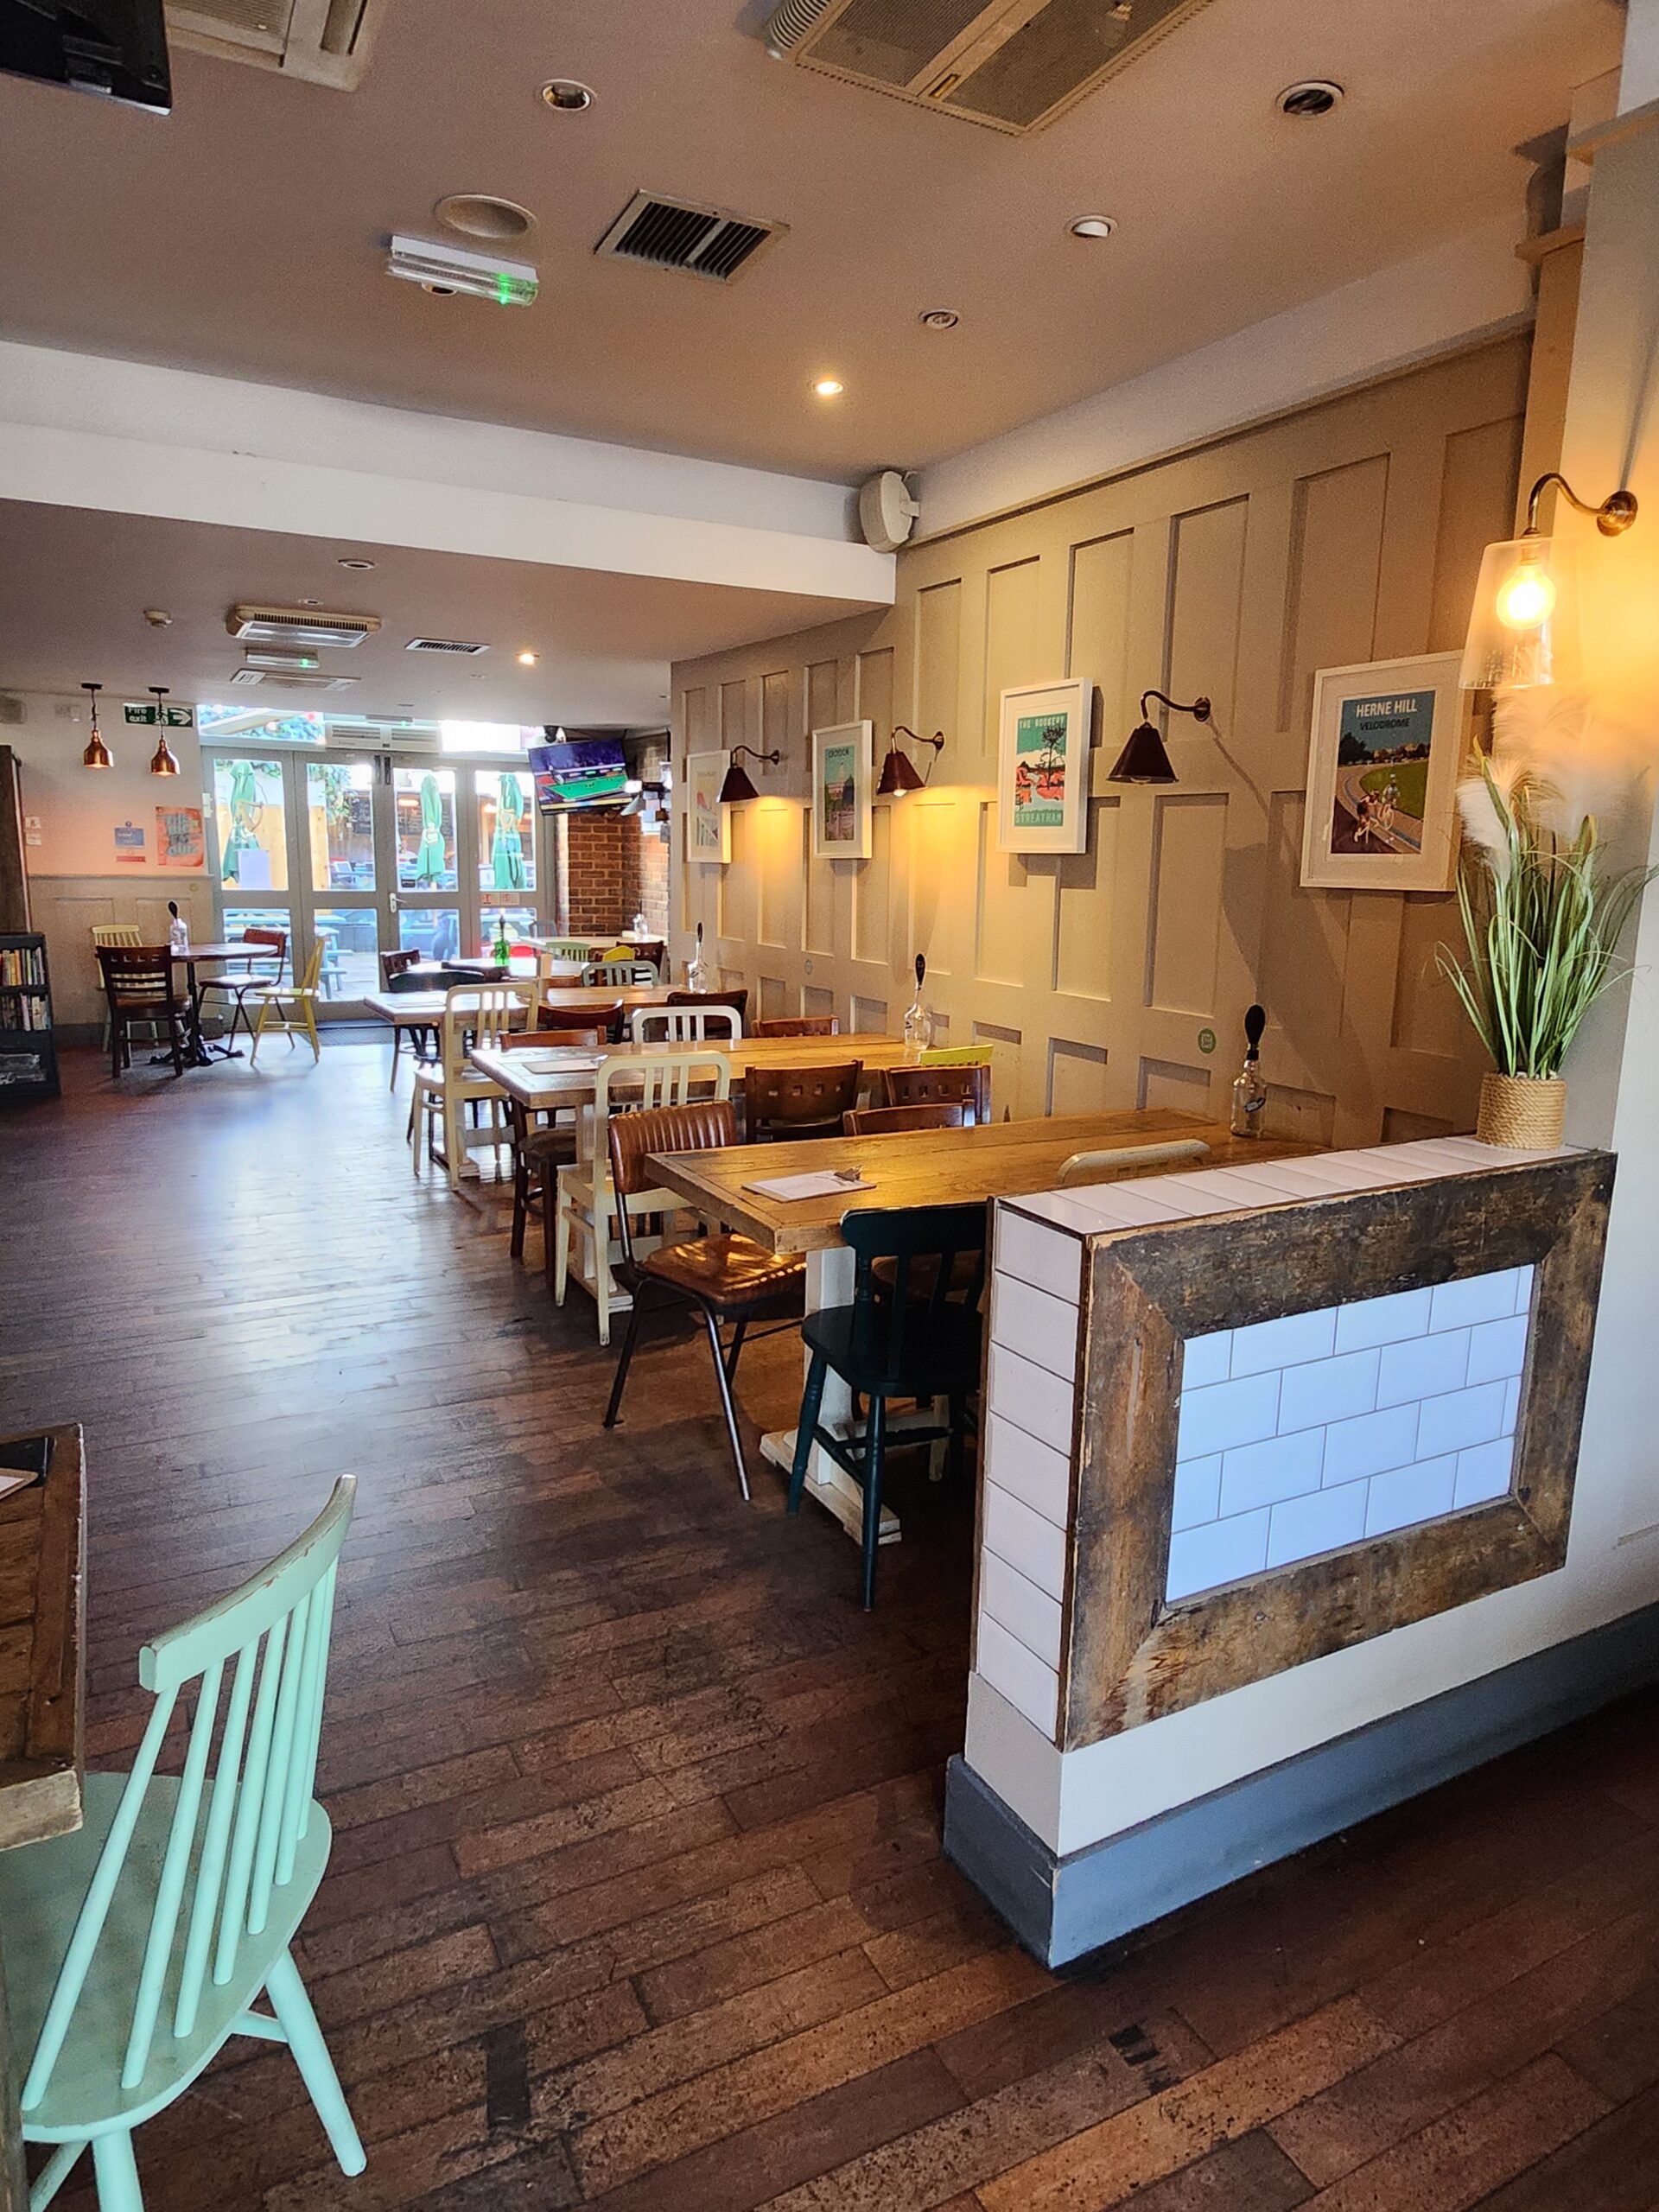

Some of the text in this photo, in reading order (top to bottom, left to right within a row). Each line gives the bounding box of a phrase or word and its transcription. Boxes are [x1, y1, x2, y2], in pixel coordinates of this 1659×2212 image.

[1356, 698, 1417, 718] HERNE HILL
[1020, 719, 1031, 728] THE
[1360, 718, 1410, 731] VELODROME
